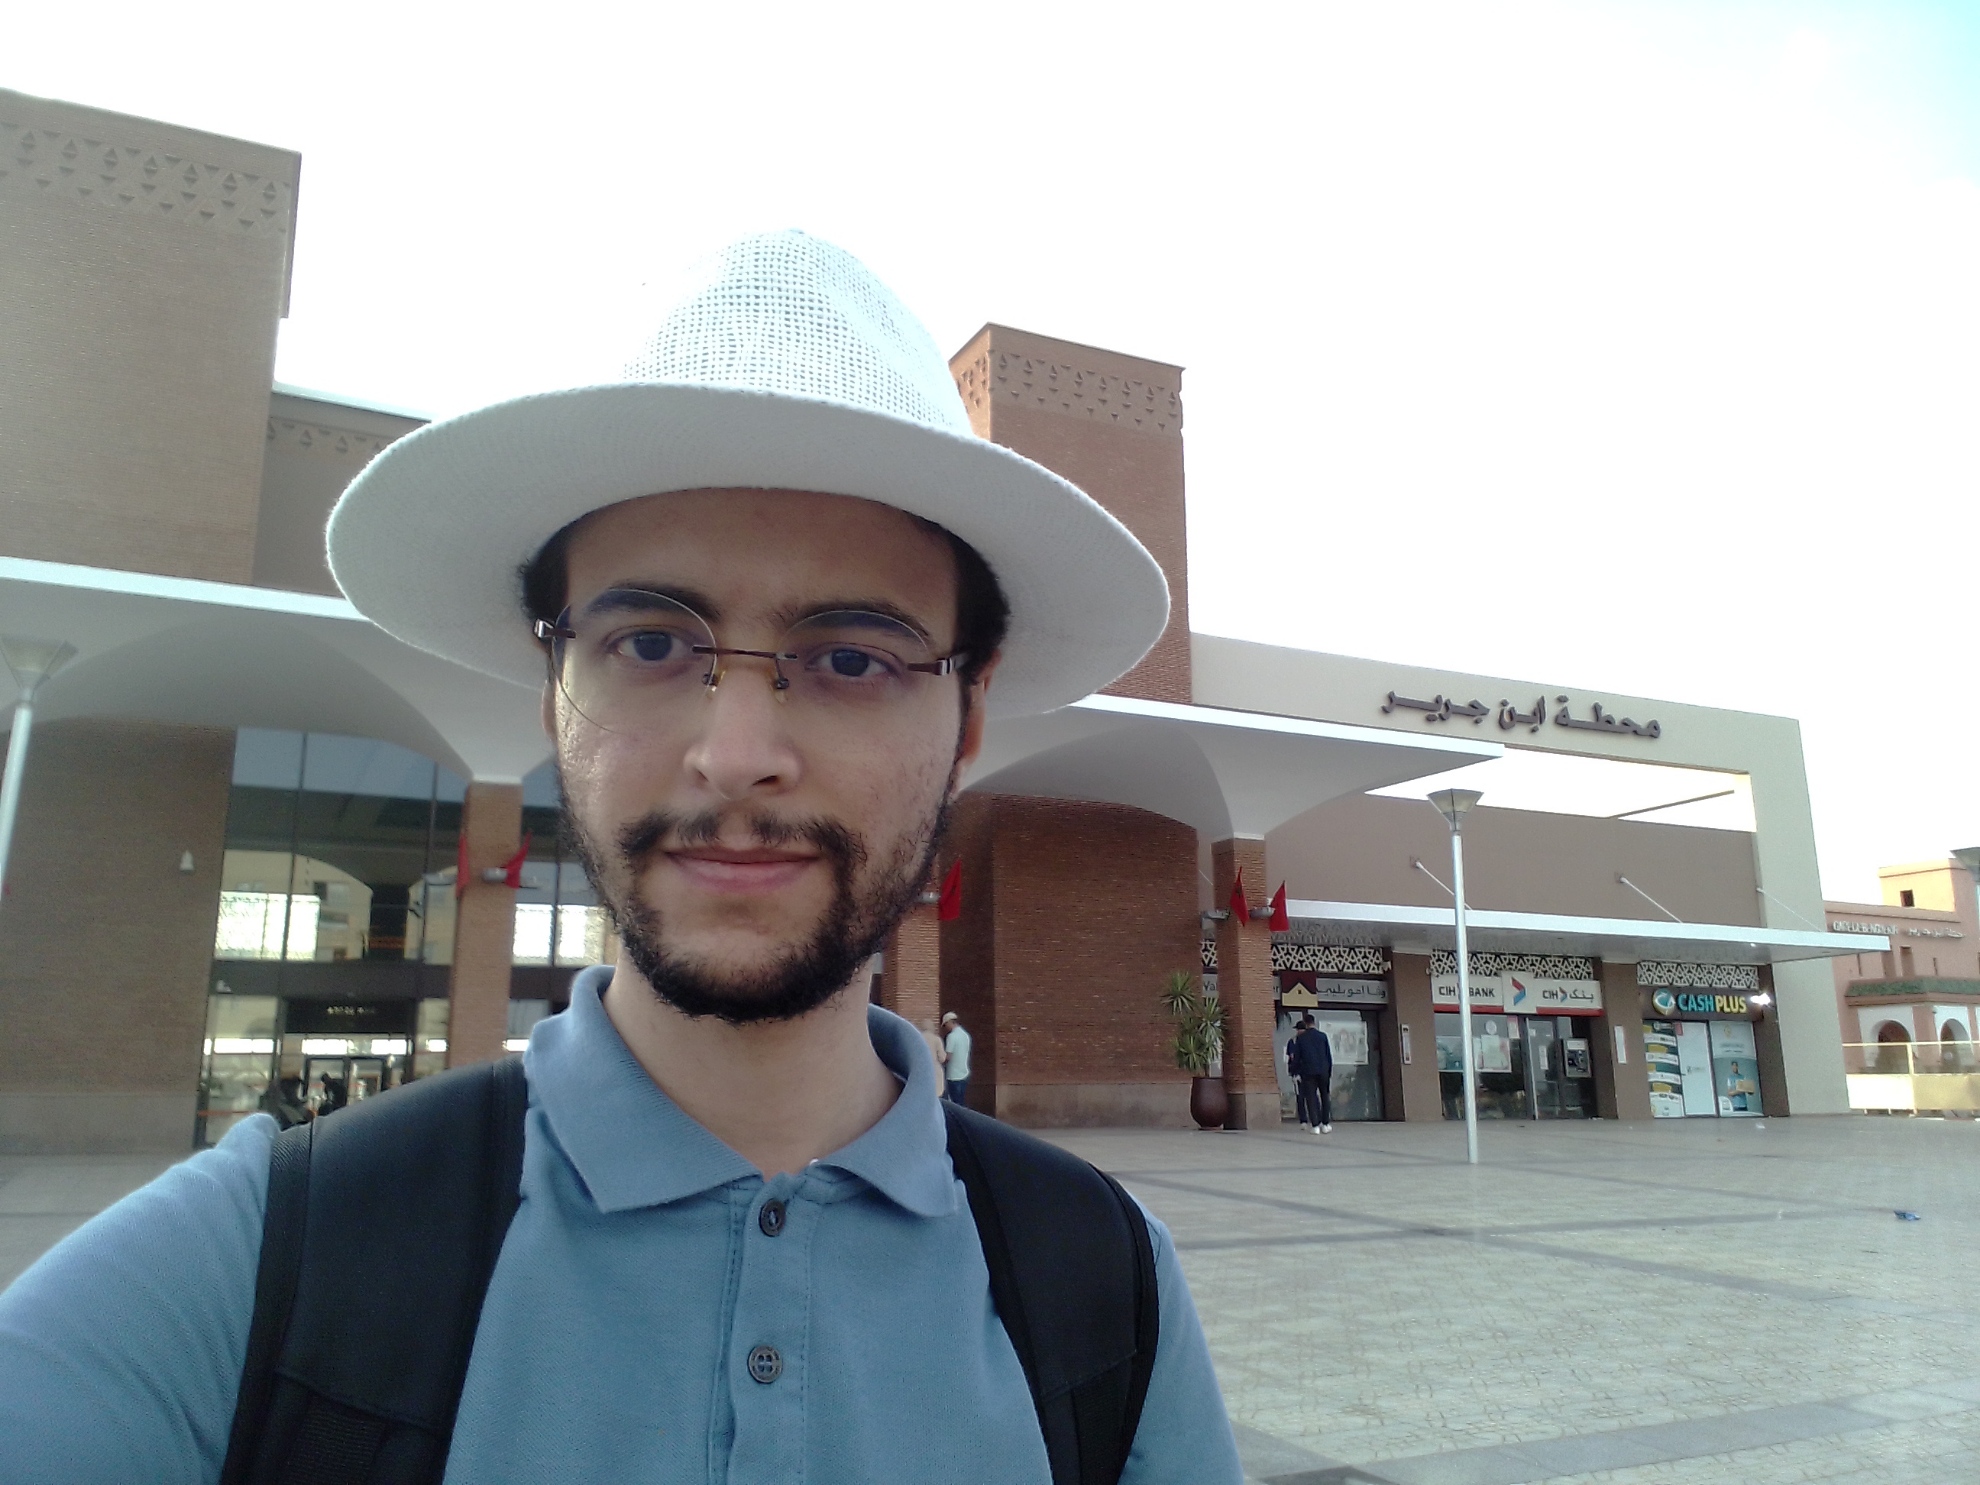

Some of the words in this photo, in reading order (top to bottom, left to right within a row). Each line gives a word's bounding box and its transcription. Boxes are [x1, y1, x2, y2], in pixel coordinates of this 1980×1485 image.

[1380, 690, 1491, 724] جرير
[1499, 695, 1547, 733] ابن
[1555, 694, 1661, 739] محطة
[1438, 985, 1456, 997] CIH
[1469, 986, 1496, 998] BANK
[1542, 989, 1559, 999] CIH
[1569, 988, 1595, 1003] بنك
